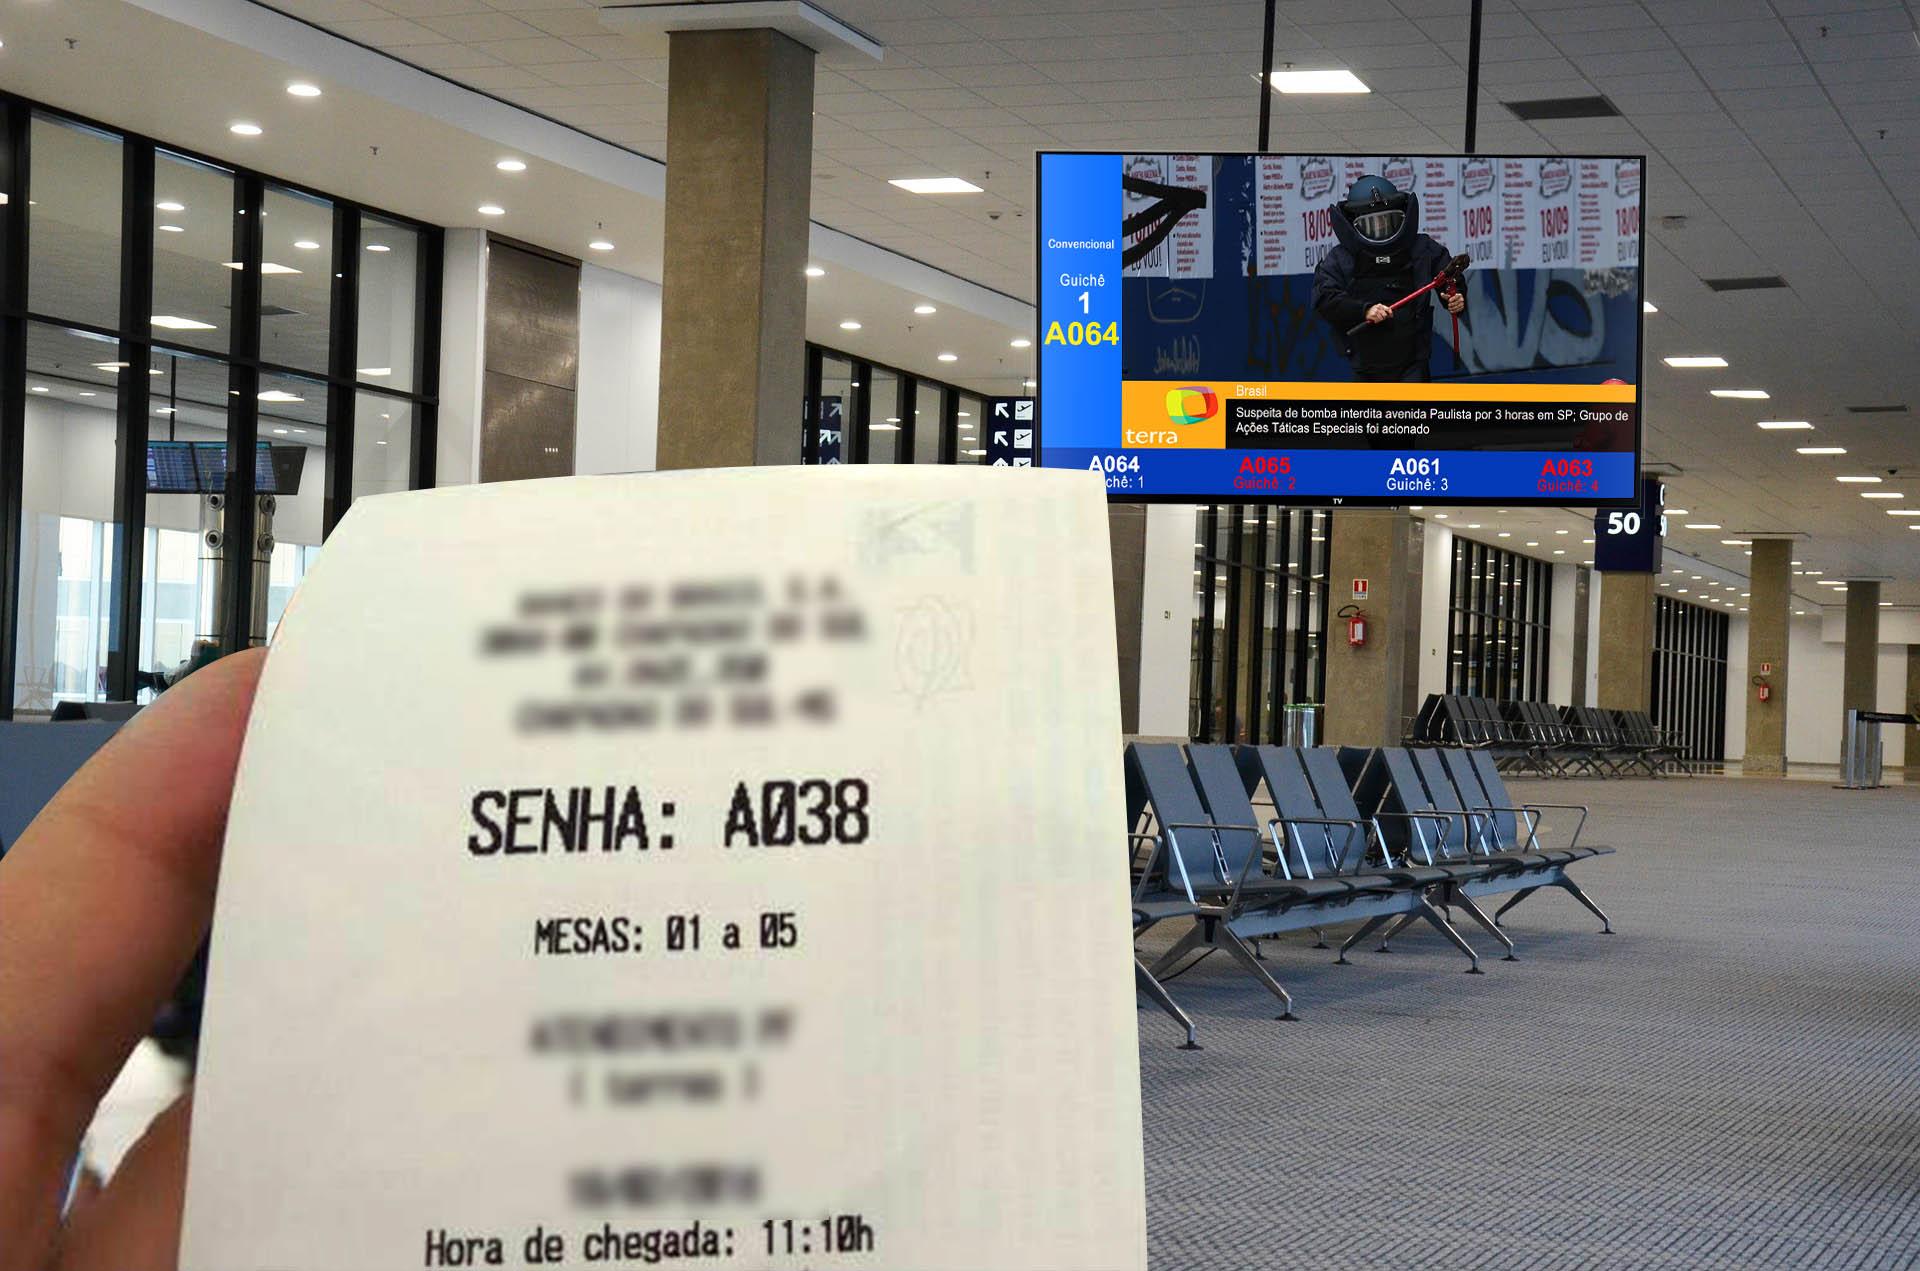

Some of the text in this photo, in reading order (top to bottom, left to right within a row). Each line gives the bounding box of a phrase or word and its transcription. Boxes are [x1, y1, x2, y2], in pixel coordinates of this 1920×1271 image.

[1462, 206, 1492, 239] 18/09
[1540, 206, 1568, 238] 18/09
[1616, 206, 1639, 237] 18/0
[1048, 238, 1114, 249] Convencional
[1060, 273, 1105, 286] Guichê
[1078, 291, 1090, 314] 1
[1044, 321, 1119, 346] A064
[1236, 385, 1267, 397] Brasil
[1236, 407, 1629, 423] Suspeita de bomba interdita avenida Paulista por 3 horas em SP; Grupo de
[1125, 429, 1178, 445] terra
[1235, 422, 1430, 436] Ações Táticas Especiais foi acionado
[1089, 455, 1140, 473] A064
[1239, 457, 1291, 474] A065
[1390, 458, 1440, 475] A061
[1541, 459, 1593, 477] A063
[1106, 475, 1144, 489] chê: 1
[1288, 477, 1296, 490] 2
[1386, 477, 1448, 491] Guichê: 3
[1591, 480, 1599, 493] 4
[1607, 512, 1641, 535] 50
[468, 779, 869, 855] SENHA: A038
[534, 912, 798, 955] MESAS: 01 a 05
[425, 1214, 875, 1267] Hora de chegada: 11:10h
